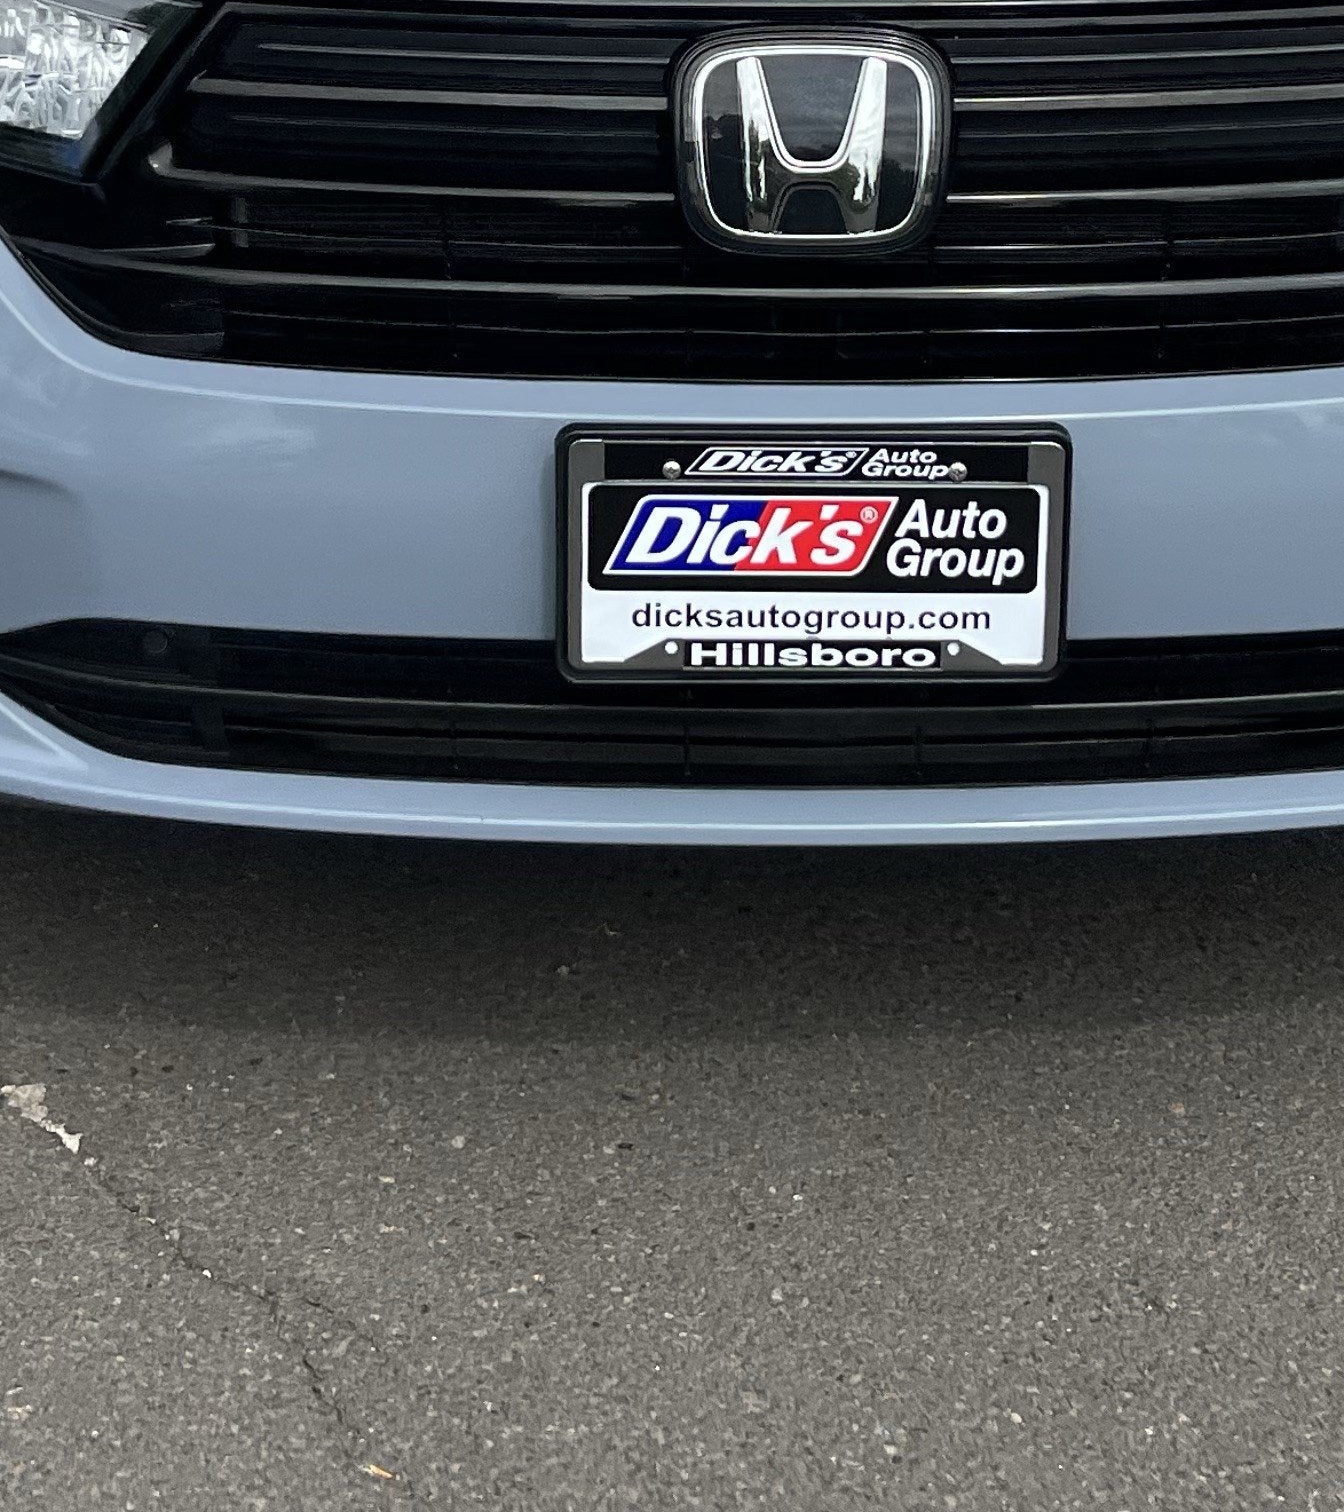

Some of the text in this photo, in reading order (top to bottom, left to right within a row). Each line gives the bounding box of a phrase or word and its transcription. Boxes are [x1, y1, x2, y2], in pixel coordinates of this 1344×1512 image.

[699, 449, 847, 473] Dick's
[867, 448, 937, 464] Auto
[861, 462, 948, 480] Group
[894, 498, 1007, 539] Auto
[624, 504, 865, 565] Dick's
[886, 538, 1025, 585] Group
[631, 603, 990, 635] dicksautogroup.com
[690, 642, 936, 667] Hillsboro
